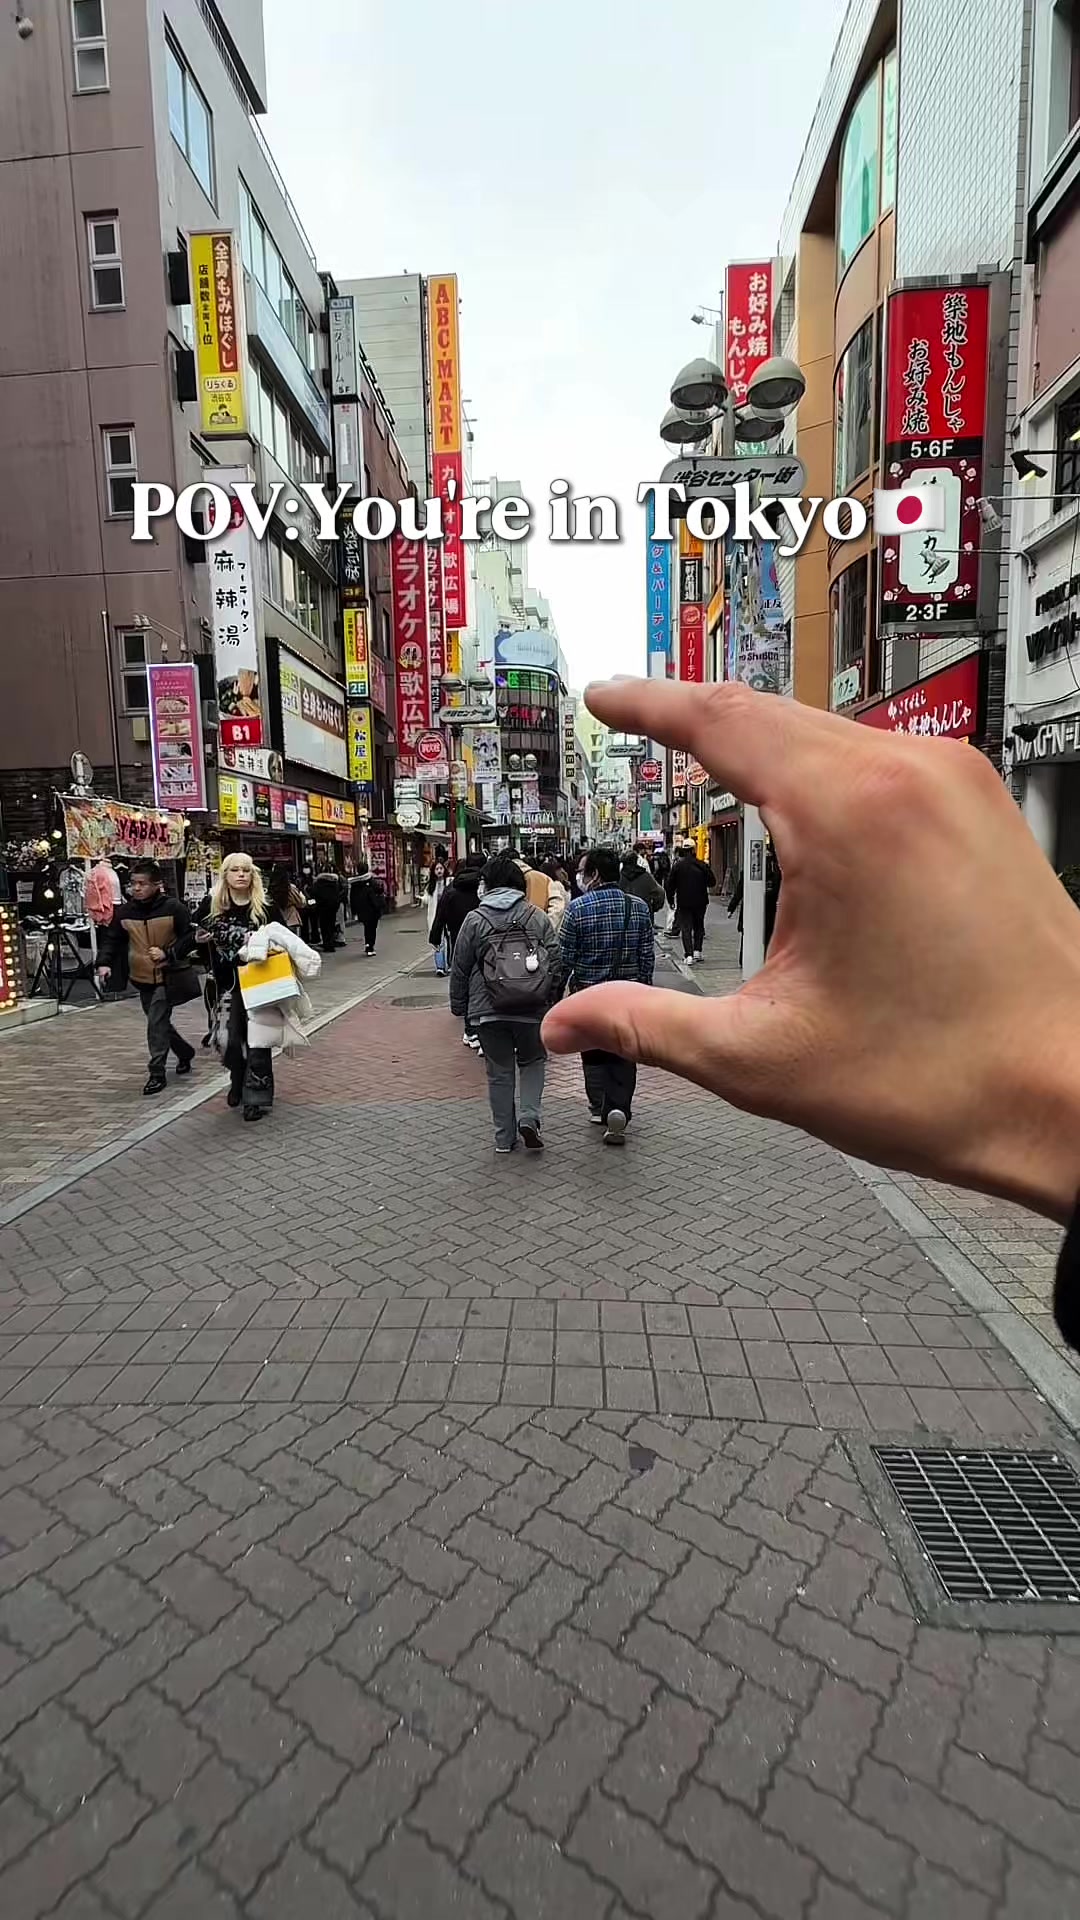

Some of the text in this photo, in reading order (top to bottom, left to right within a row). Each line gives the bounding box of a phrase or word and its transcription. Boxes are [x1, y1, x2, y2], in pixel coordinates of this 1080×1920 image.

[214, 239, 236, 370] 全身もみほぐし
[748, 271, 768, 357] お好み焼
[728, 316, 748, 398] もんじゃ
[901, 338, 931, 435] お好み焼
[942, 293, 968, 433] 築地もんじゃ
[673, 466, 798, 488] 渋谷センター街
[214, 550, 240, 646] 麻辣湯
[350, 682, 365, 694] 2F
[231, 725, 250, 741] B1
